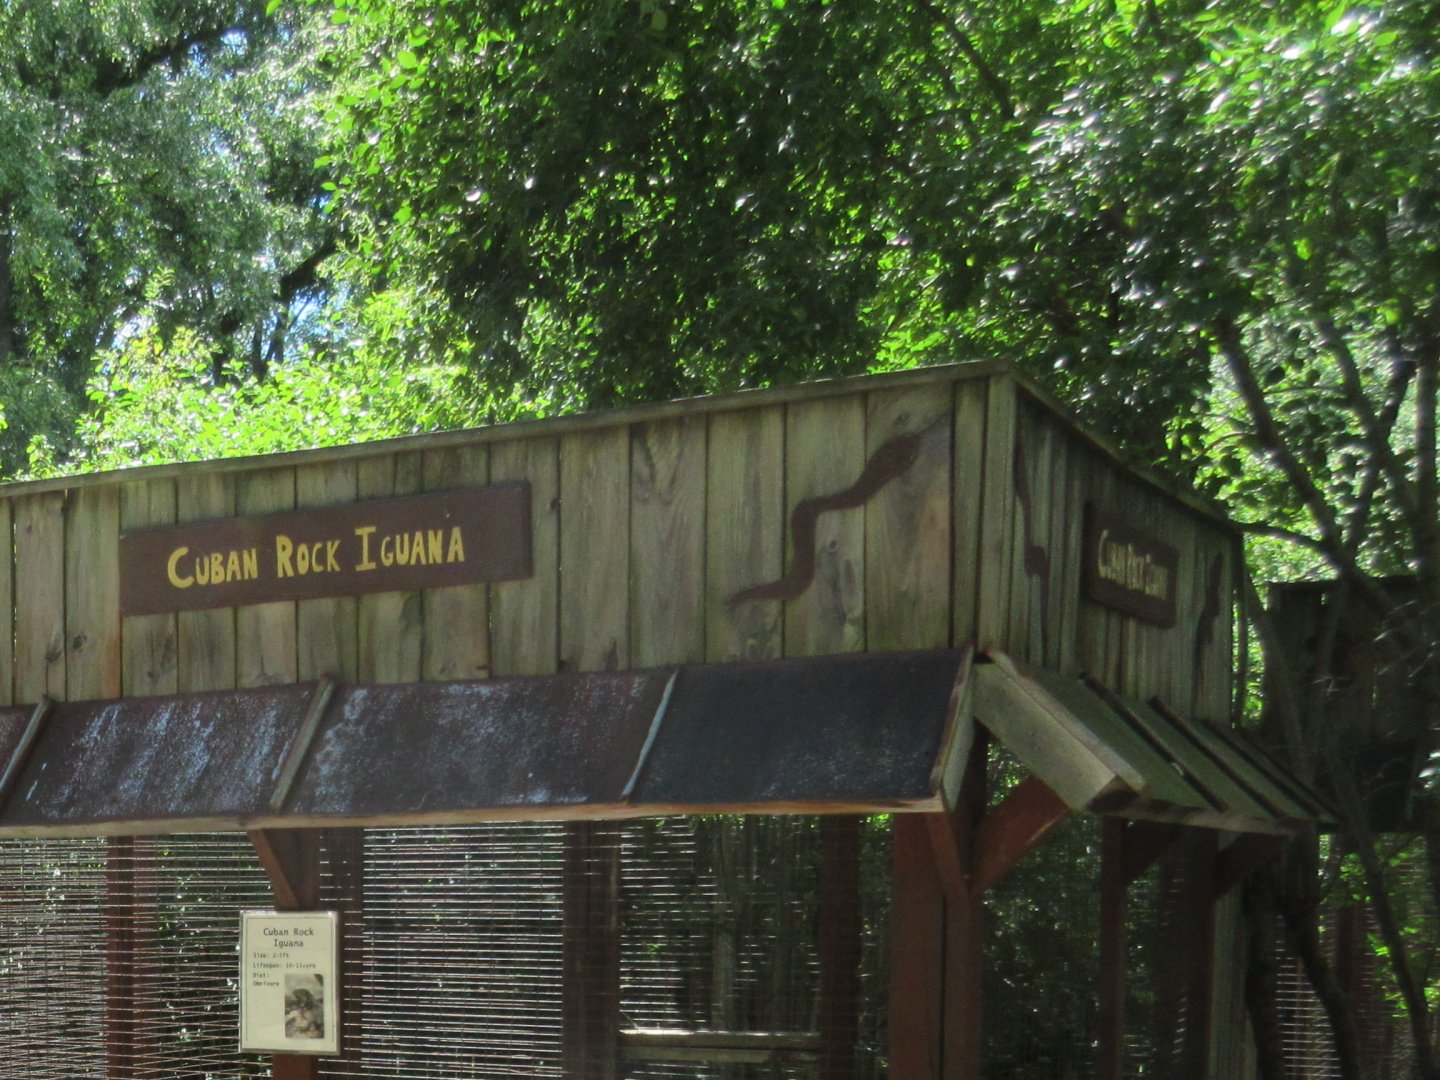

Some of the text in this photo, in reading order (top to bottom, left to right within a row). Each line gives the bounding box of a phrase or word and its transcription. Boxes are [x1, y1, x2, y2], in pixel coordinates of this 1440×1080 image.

[167, 526, 465, 588] CUBAN ROCK IGUANA
[263, 927, 314, 936] Cuban Rock
[274, 939, 304, 948] Iguana
